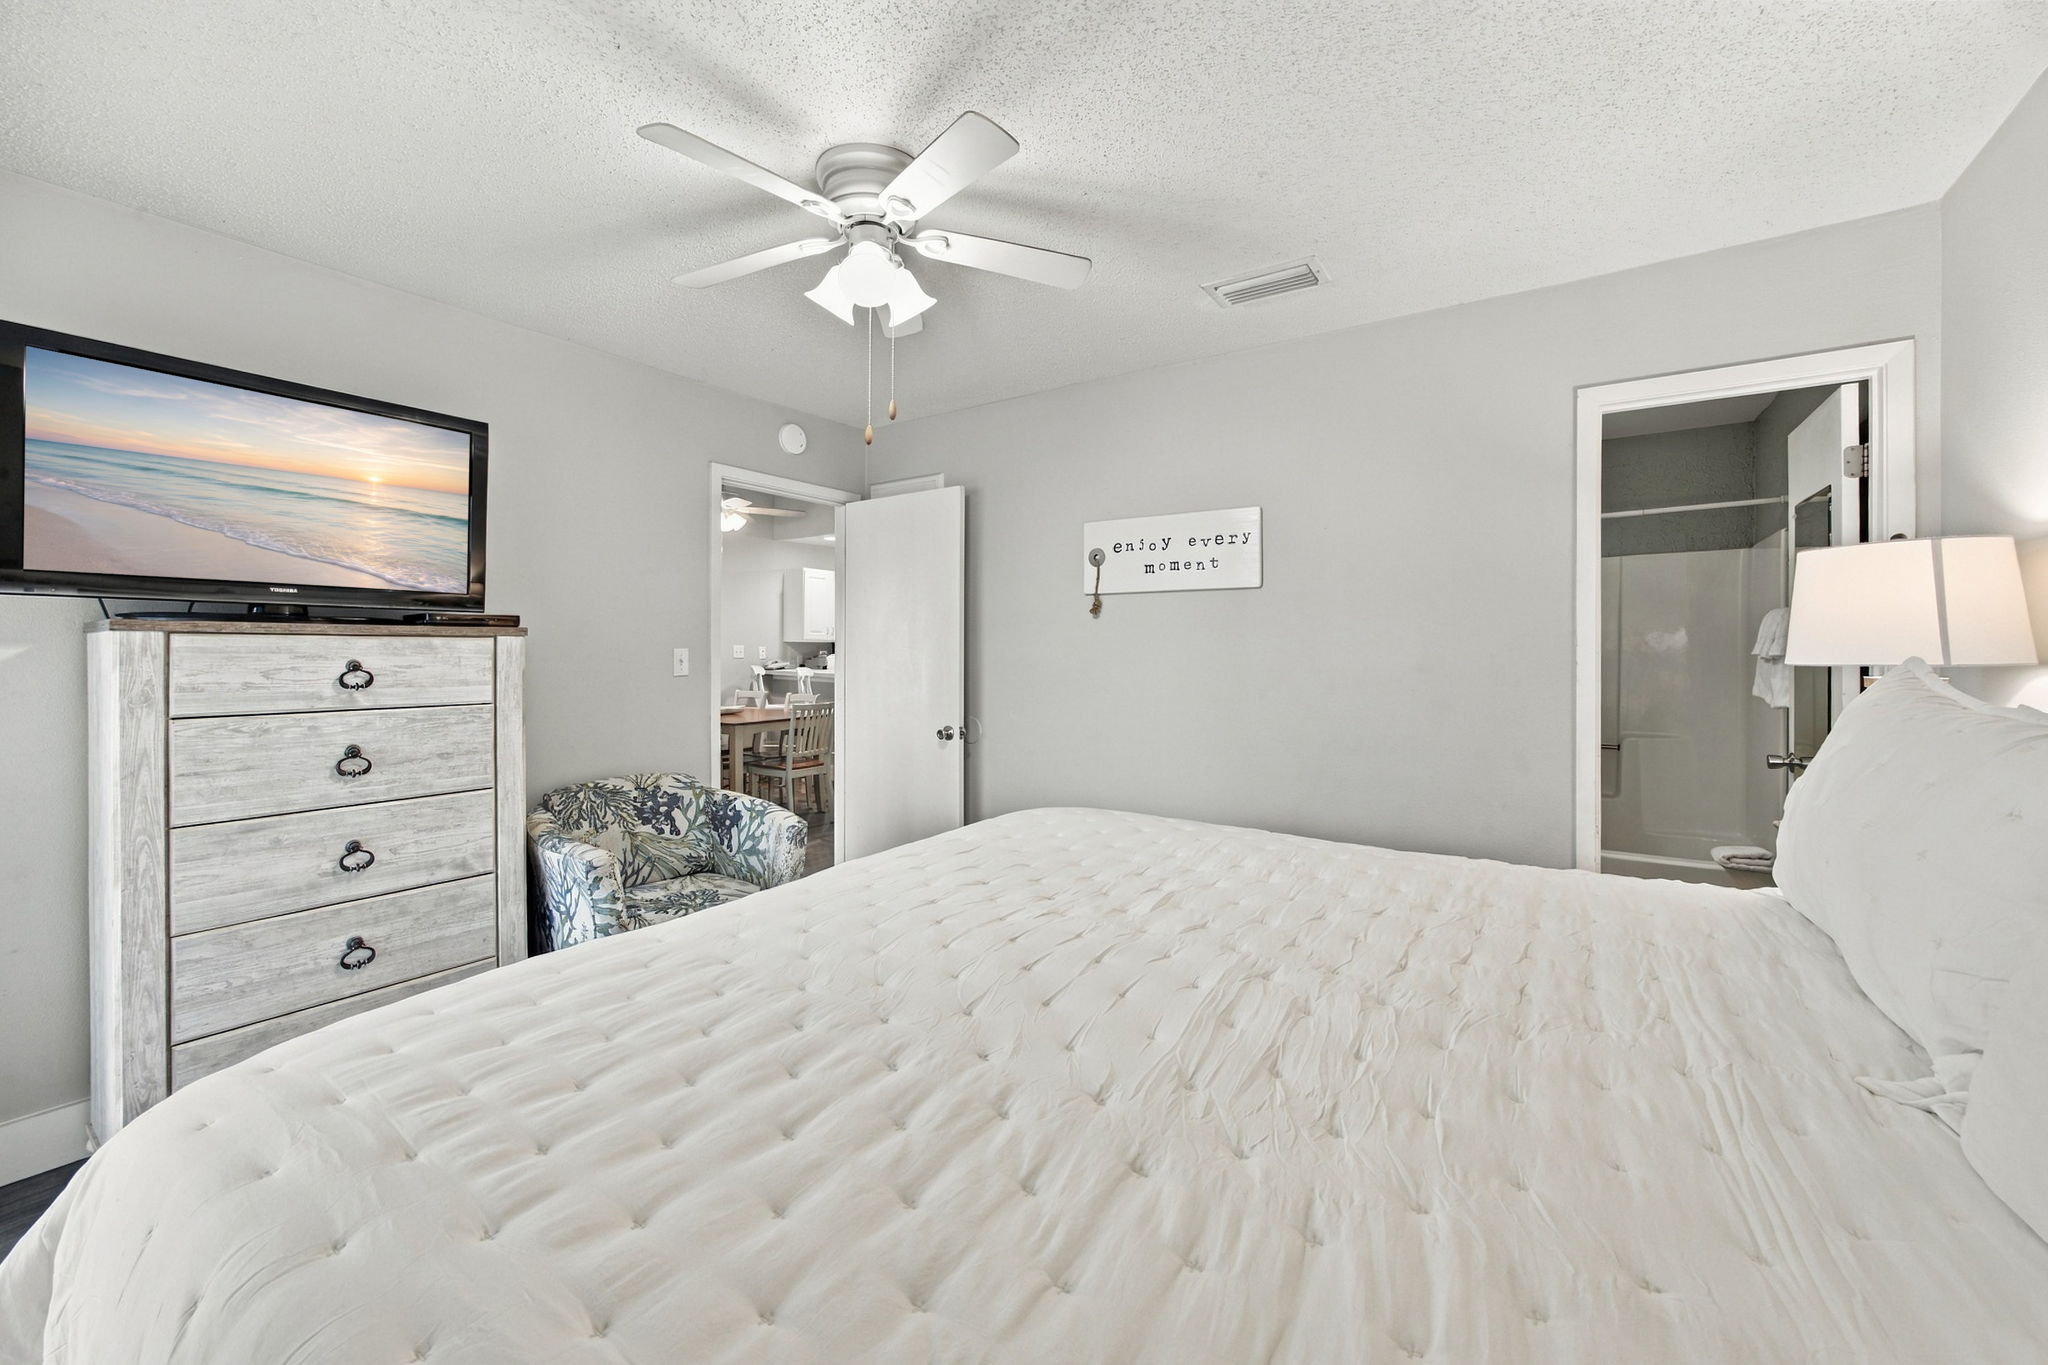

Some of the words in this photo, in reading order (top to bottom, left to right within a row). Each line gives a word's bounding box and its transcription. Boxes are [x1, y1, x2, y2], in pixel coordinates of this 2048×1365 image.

[1113, 537, 1171, 553] enjoy
[1188, 531, 1251, 547] every
[1144, 557, 1219, 574] moment
